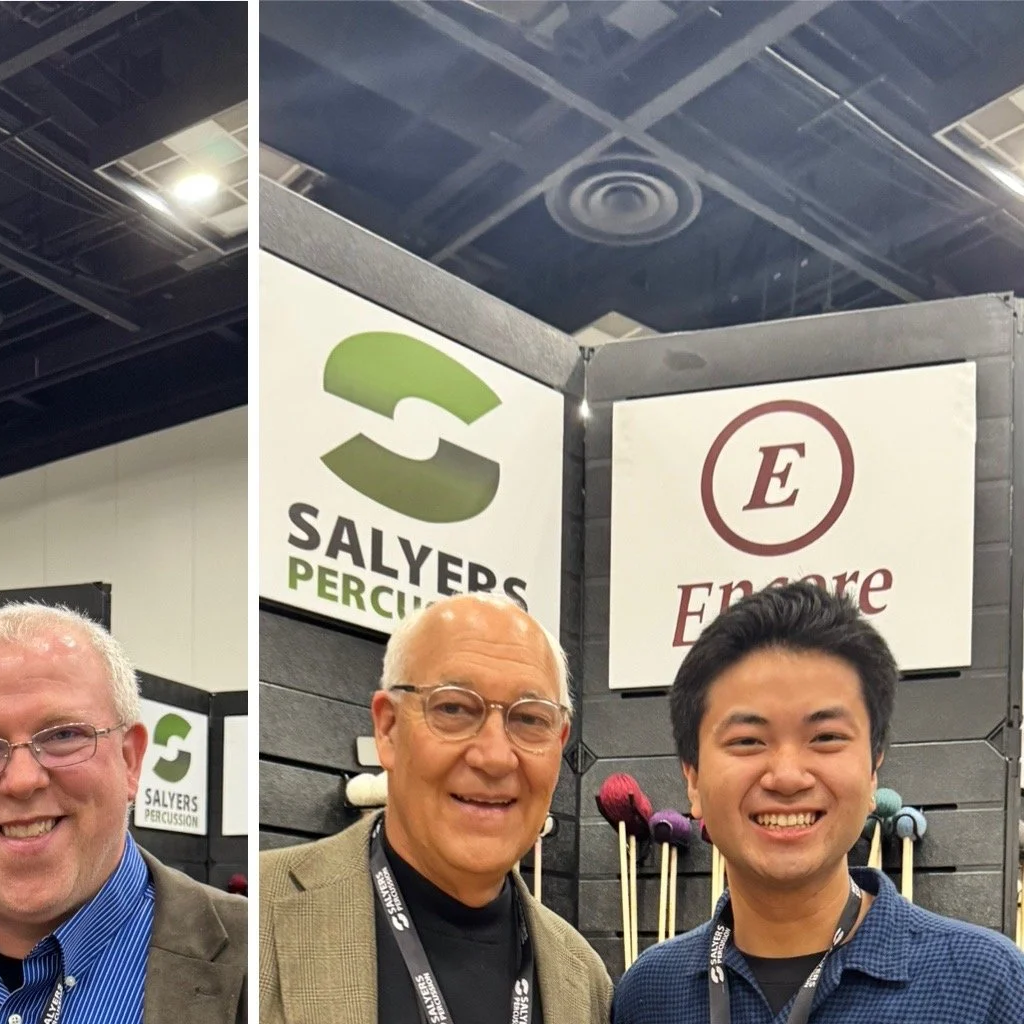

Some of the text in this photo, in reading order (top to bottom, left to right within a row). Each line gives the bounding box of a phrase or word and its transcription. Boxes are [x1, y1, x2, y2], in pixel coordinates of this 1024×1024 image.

[743, 442, 806, 512] E
[288, 502, 528, 613] SALYERS
[672, 567, 893, 647] Enre
[144, 788, 198, 812] SALYERS
[144, 808, 198, 828] PERCUSSION
[375, 872, 397, 916] SALYERS
[710, 924, 726, 967] SALYERS
[415, 975, 439, 1024] SALYERS
[423, 972, 446, 1021] PERCUSSION
